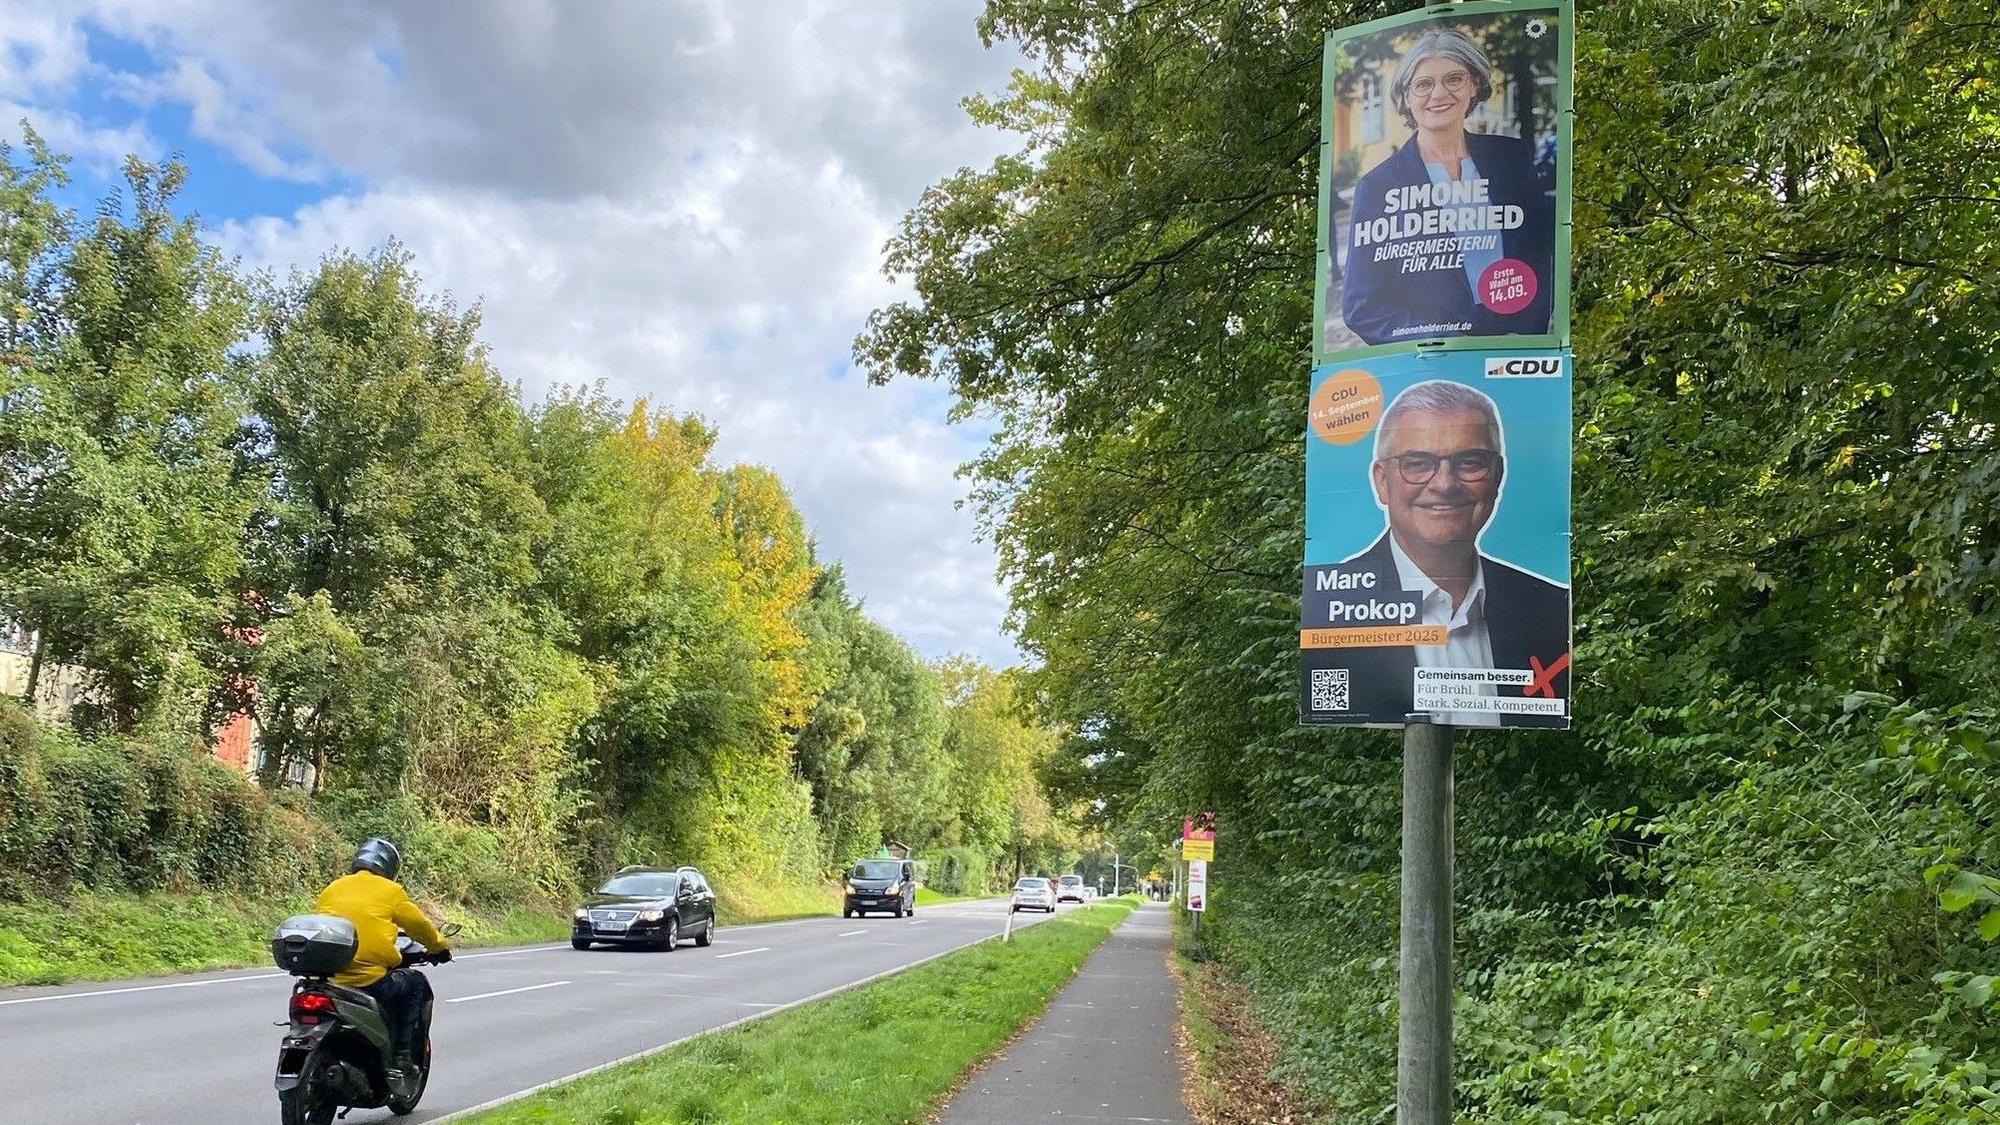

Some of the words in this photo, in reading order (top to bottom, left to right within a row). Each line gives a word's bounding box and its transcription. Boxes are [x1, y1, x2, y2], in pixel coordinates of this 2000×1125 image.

[1384, 178, 1489, 214] SIMONE
[1354, 205, 1524, 248] HOLDERRIED
[1374, 235, 1497, 262] BÜRGERMEISTERIN
[1401, 255, 1428, 274] FÜR
[1429, 253, 1465, 271] ALLE
[1489, 277, 1509, 290] Wahl
[1510, 275, 1523, 285] am
[1493, 268, 1514, 280] Erste
[1489, 284, 1528, 304] 14.09.
[1391, 321, 1473, 336] simoneholderried.de
[1505, 360, 1560, 375] CDU
[1331, 386, 1358, 402] CDU
[1313, 409, 1328, 420] 14.
[1328, 394, 1380, 416] September
[1326, 410, 1370, 430] wählen
[1315, 569, 1377, 591] Marc
[1328, 598, 1417, 625] Prokop
[1311, 632, 1402, 647] Bürgermeister
[1405, 629, 1440, 642] 2025
[1417, 670, 1486, 681] Gemeinsam
[1487, 671, 1531, 683] besser.
[1417, 684, 1438, 694] Für
[1440, 684, 1475, 696] Brühl.
[1417, 697, 1450, 709] Stark.
[1453, 698, 1490, 710] Sozial.
[1493, 700, 1561, 713] Kompetent.
